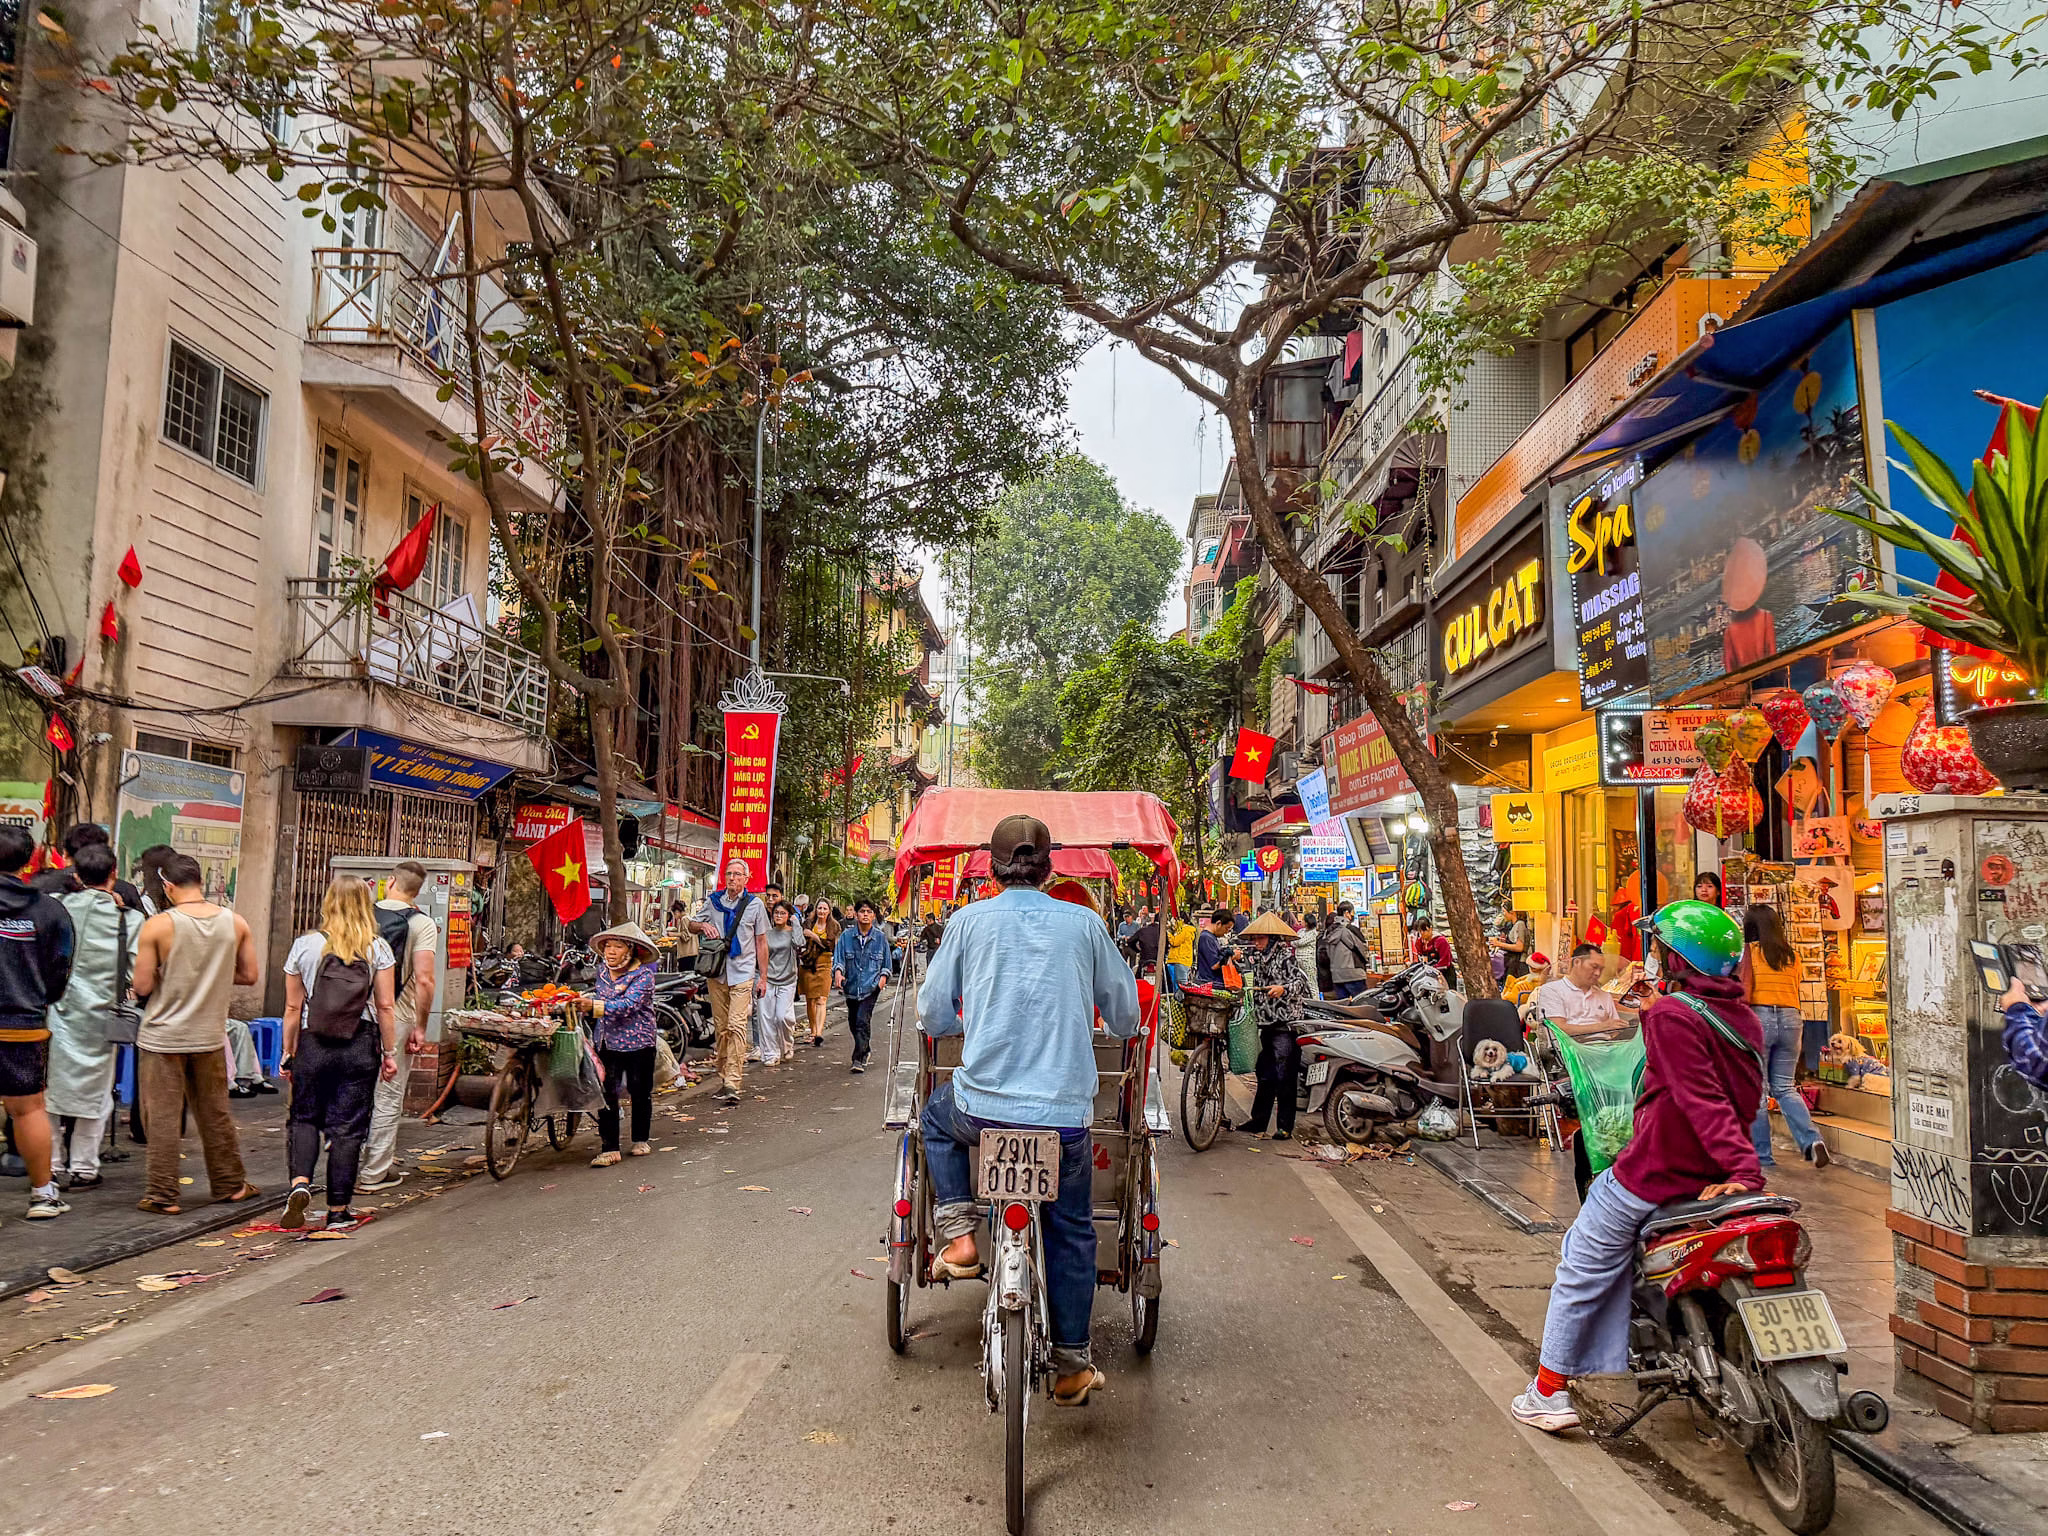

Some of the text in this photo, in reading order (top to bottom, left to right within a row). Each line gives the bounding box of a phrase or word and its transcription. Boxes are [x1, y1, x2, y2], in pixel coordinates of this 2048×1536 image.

[1612, 466, 1635, 492] Young
[1567, 496, 1632, 576] Spa
[1444, 557, 1538, 675] CULCAT
[1339, 731, 1357, 748] Shop
[1650, 737, 1677, 752] CHUYÊN
[377, 756, 396, 769] Y
[406, 763, 452, 782] HÀNG
[753, 757, 767, 767] CAO
[1340, 748, 1361, 779] MADE
[1360, 743, 1371, 770] IN
[1627, 766, 1683, 779] Waxing
[1675, 756, 1694, 764] Quốc
[1349, 773, 1370, 791] OUTLET
[1370, 764, 1399, 785] FACTORY
[515, 819, 547, 838] BÁNH
[1303, 838, 1345, 846] BOOKING OFFICE
[1303, 847, 1345, 855] MONEY EXCHANGE
[1926, 1104, 1934, 1116] XE
[997, 1136, 1045, 1168] 29XL
[989, 1166, 1050, 1195] 0036
[1753, 1297, 1820, 1327] 30-H8
[1764, 1325, 1831, 1356] 3338
